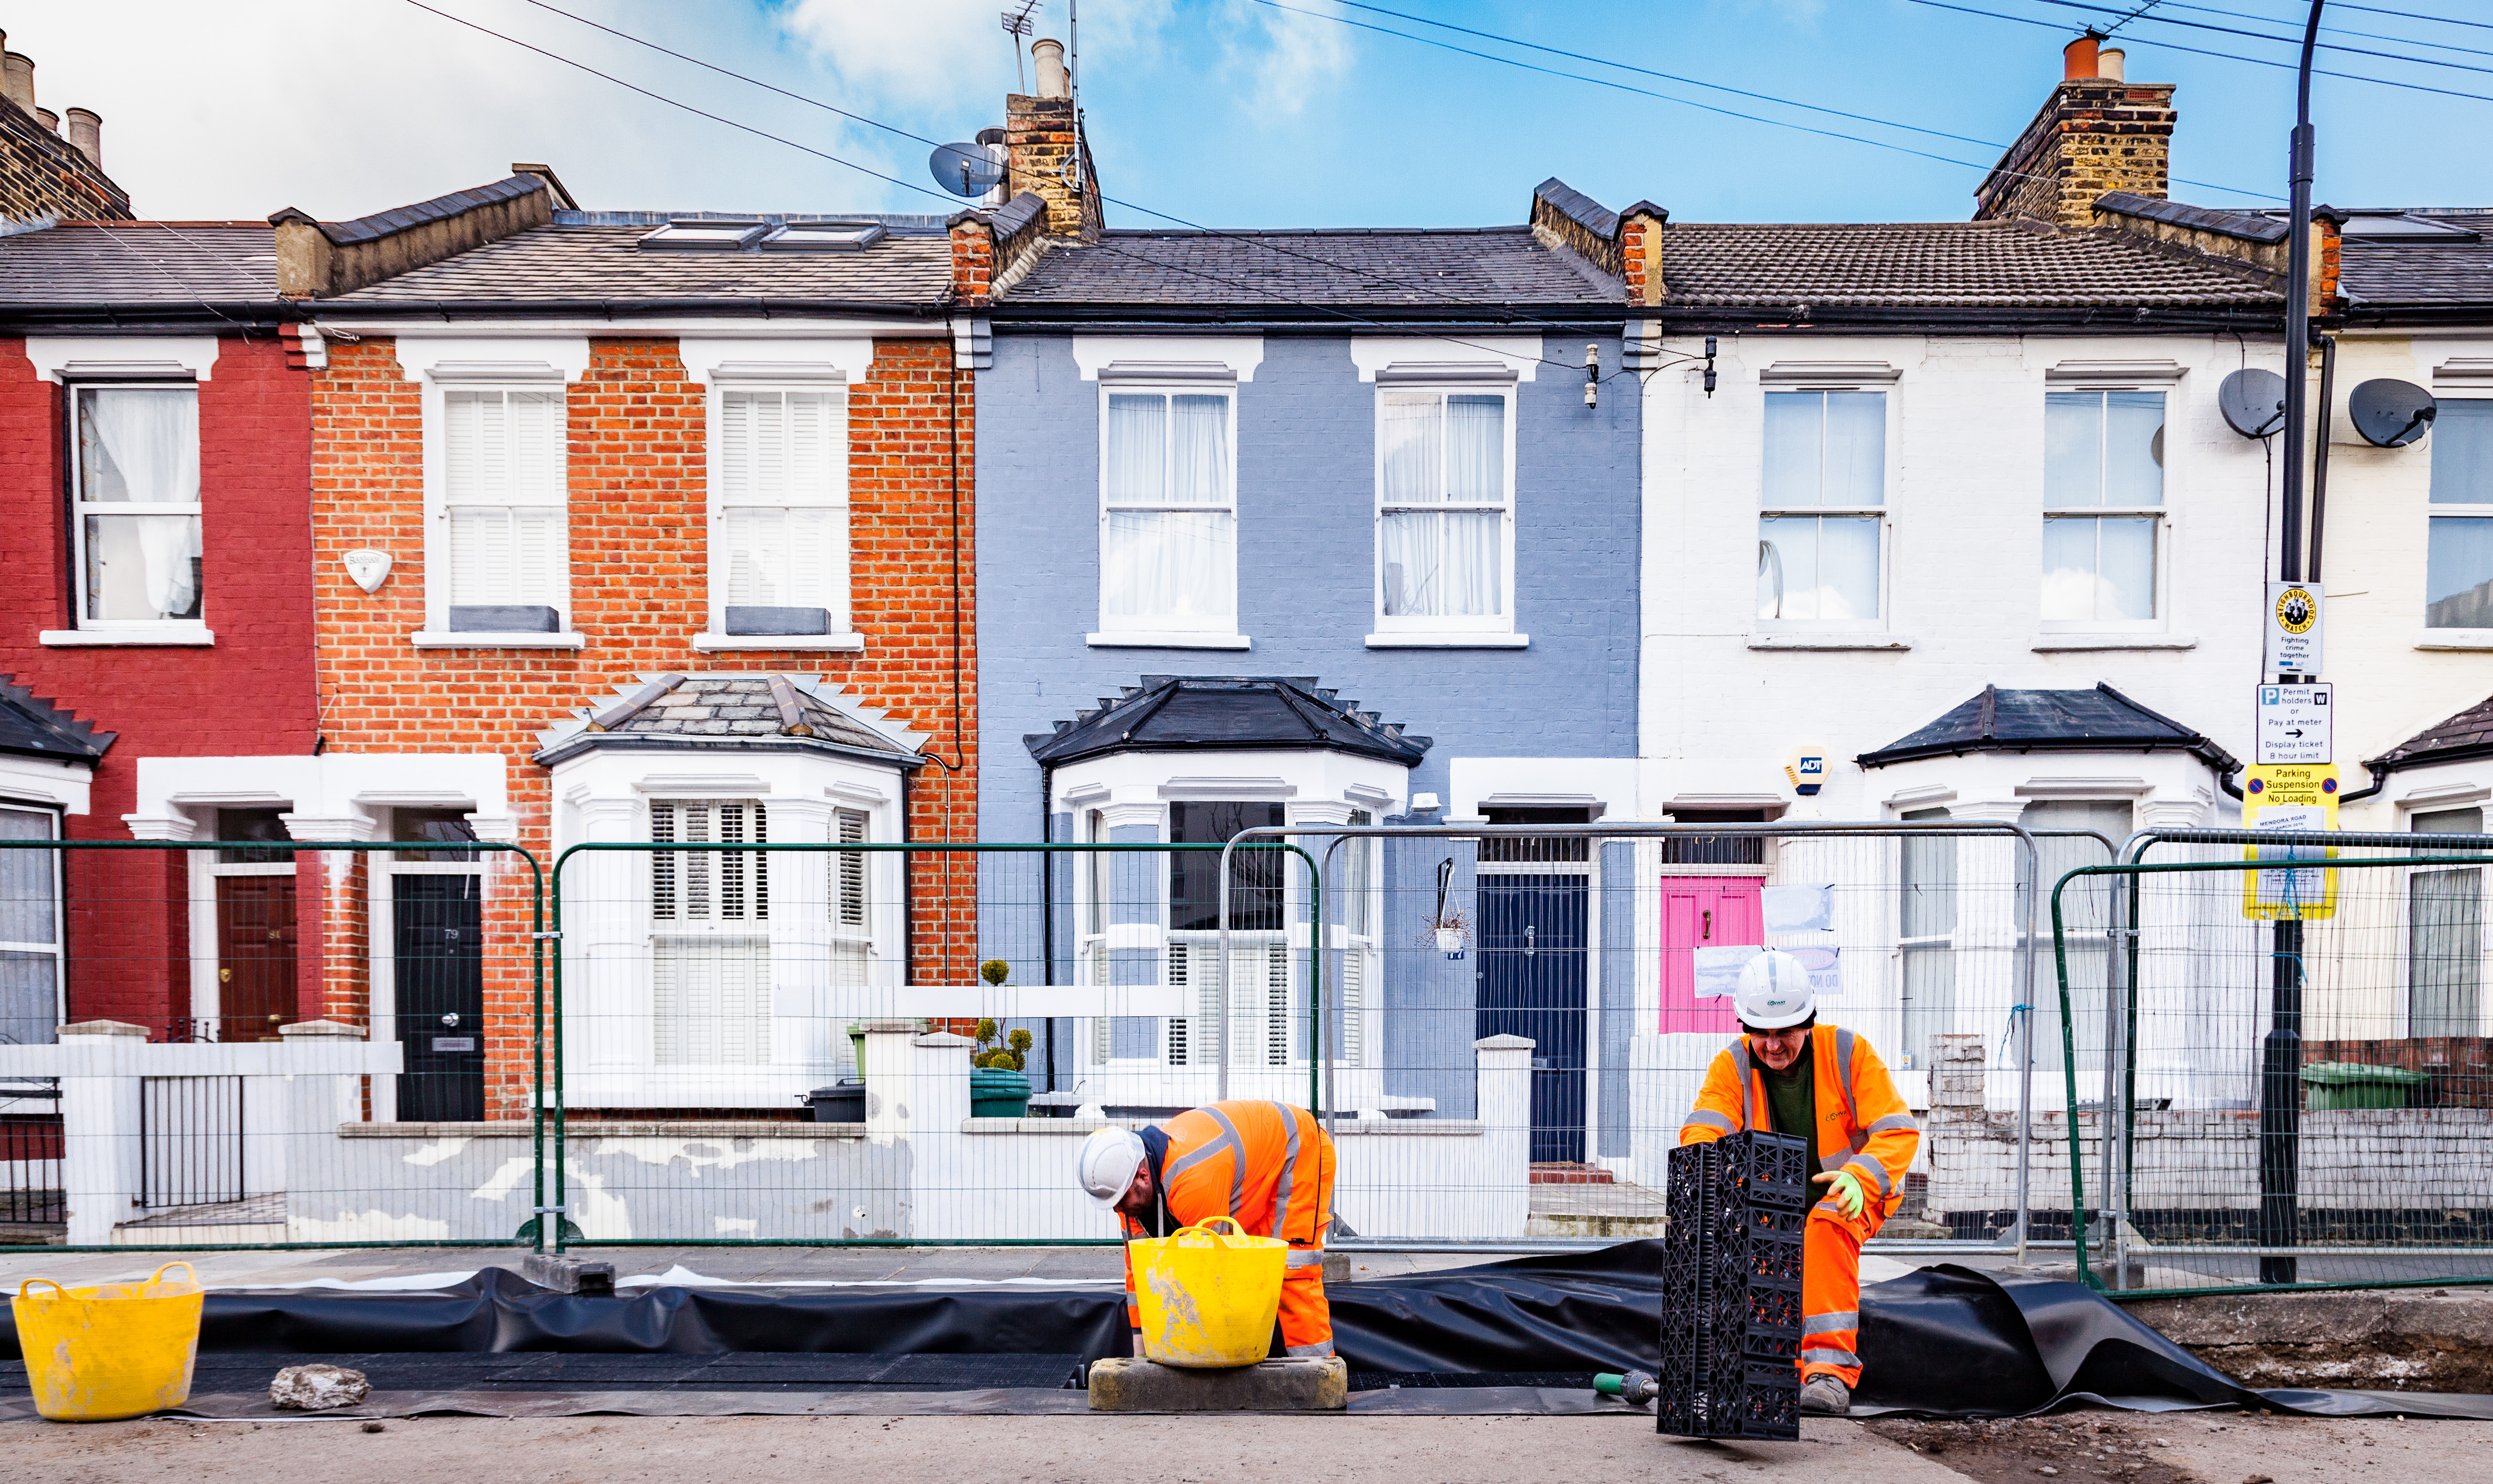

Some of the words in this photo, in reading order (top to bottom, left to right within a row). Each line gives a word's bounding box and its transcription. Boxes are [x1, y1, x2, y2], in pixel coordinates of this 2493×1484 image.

[2278, 591, 2314, 620] NEIGHBOURHOOD
[2284, 622, 2307, 632] WATCH
[2281, 636, 2309, 645] Fighting
[2265, 689, 2277, 704] P
[2316, 694, 2326, 704] W
[2266, 741, 2296, 749] Display
[1800, 760, 1822, 771] ADT
[2276, 769, 2311, 779] Parking
[2266, 780, 2320, 790] Suspension
[2268, 794, 2280, 802] No
[2283, 793, 2317, 804] Loading
[444, 929, 458, 939] 79
